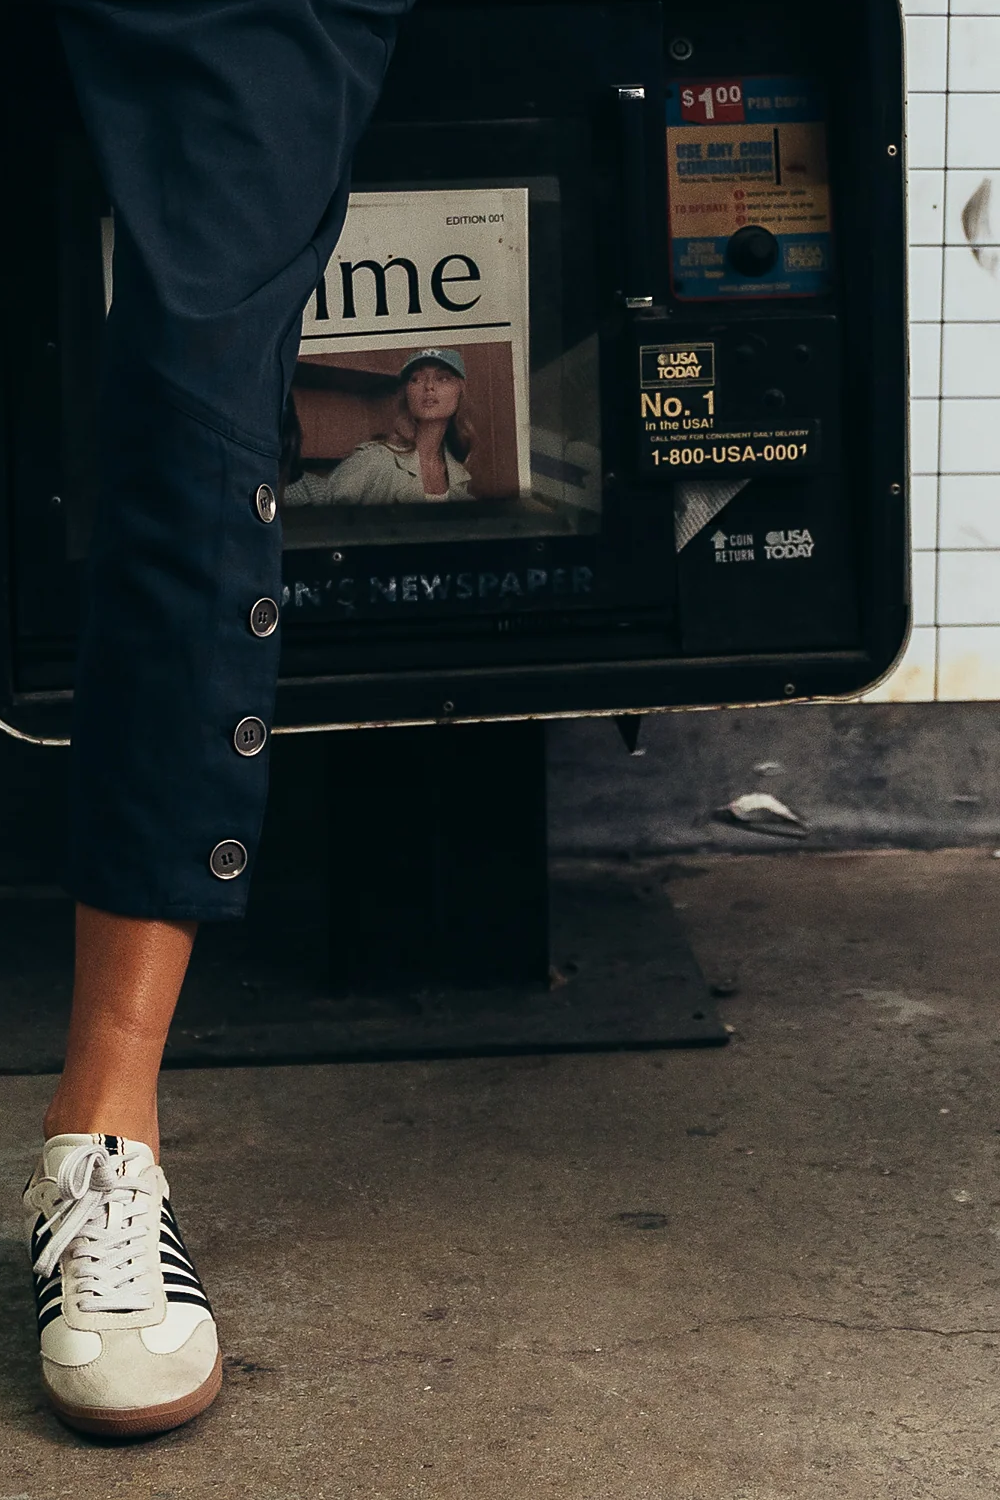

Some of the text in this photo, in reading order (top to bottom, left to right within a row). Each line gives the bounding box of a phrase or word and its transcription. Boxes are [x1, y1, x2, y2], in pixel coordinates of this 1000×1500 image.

[675, 204, 687, 214] TO
[446, 214, 505, 225] EDITION 001
[670, 352, 698, 364] USA
[657, 366, 702, 379] TODAY
[641, 390, 714, 418] No. 1
[645, 418, 714, 431] in the USA!
[689, 433, 704, 441] FOR
[706, 432, 751, 440] CONVENIENT
[753, 431, 773, 439] DAILY
[775, 429, 809, 437] DELIVERY
[651, 443, 808, 466] 1-800-USA-0001
[730, 534, 754, 546] COIN
[780, 529, 813, 544] USA
[715, 549, 755, 562] RETURN
[764, 543, 815, 559] TODAY
[370, 566, 594, 601] NEWSPAPER
